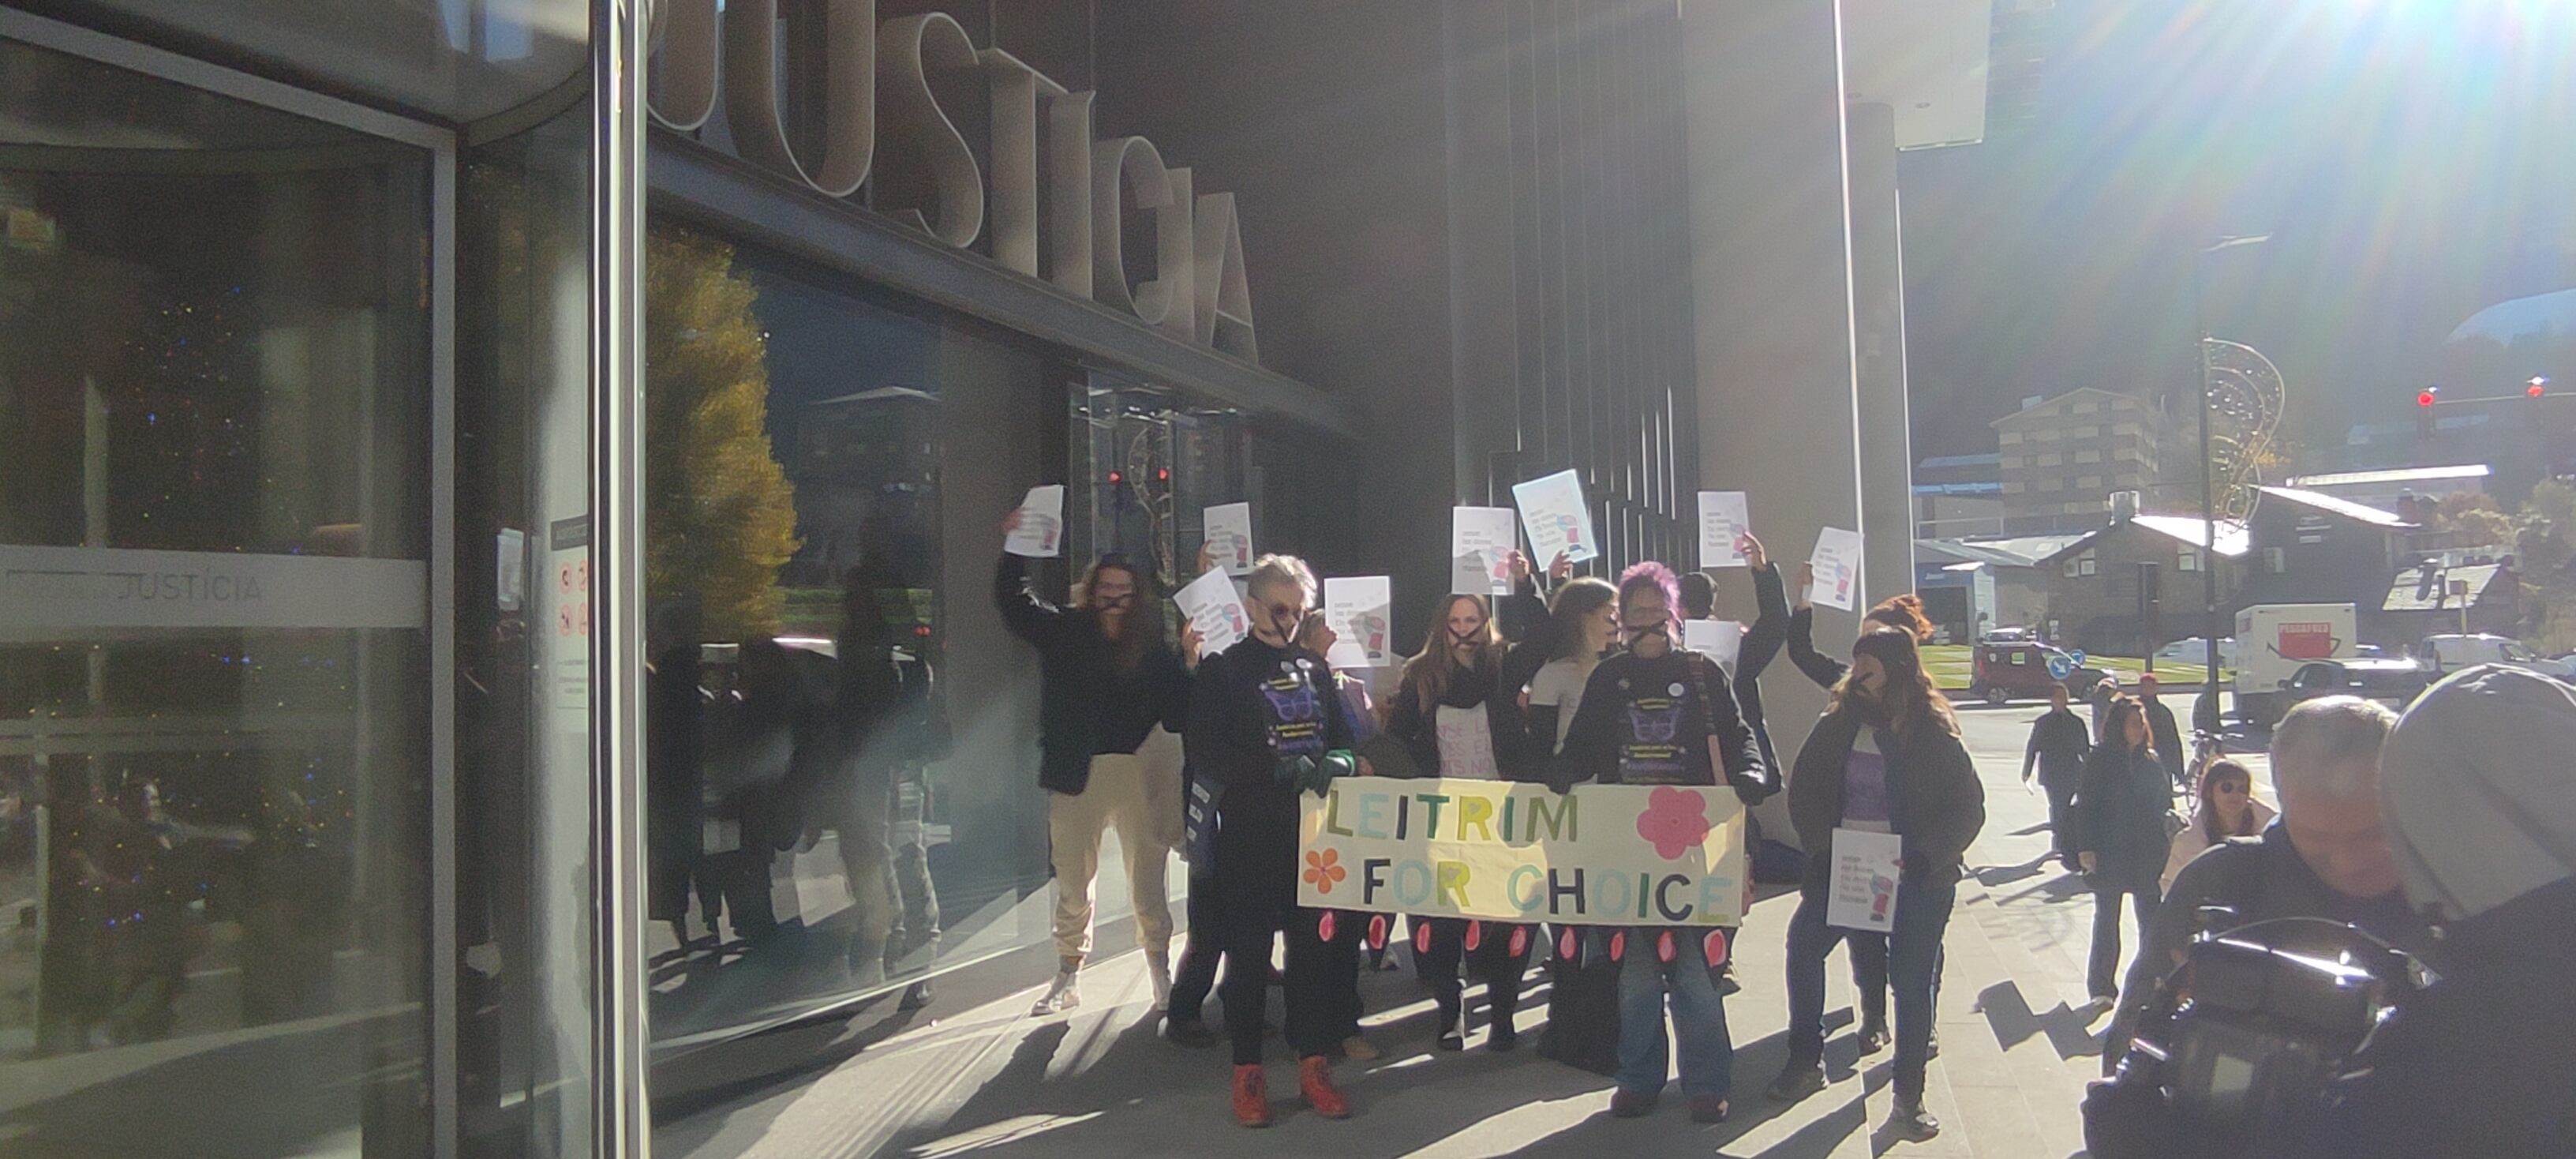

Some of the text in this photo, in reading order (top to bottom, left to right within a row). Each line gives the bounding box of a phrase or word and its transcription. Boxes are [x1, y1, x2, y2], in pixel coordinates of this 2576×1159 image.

[1327, 789, 1578, 843] LEITRIM
[1363, 858, 1733, 923] FOR CHOICE
